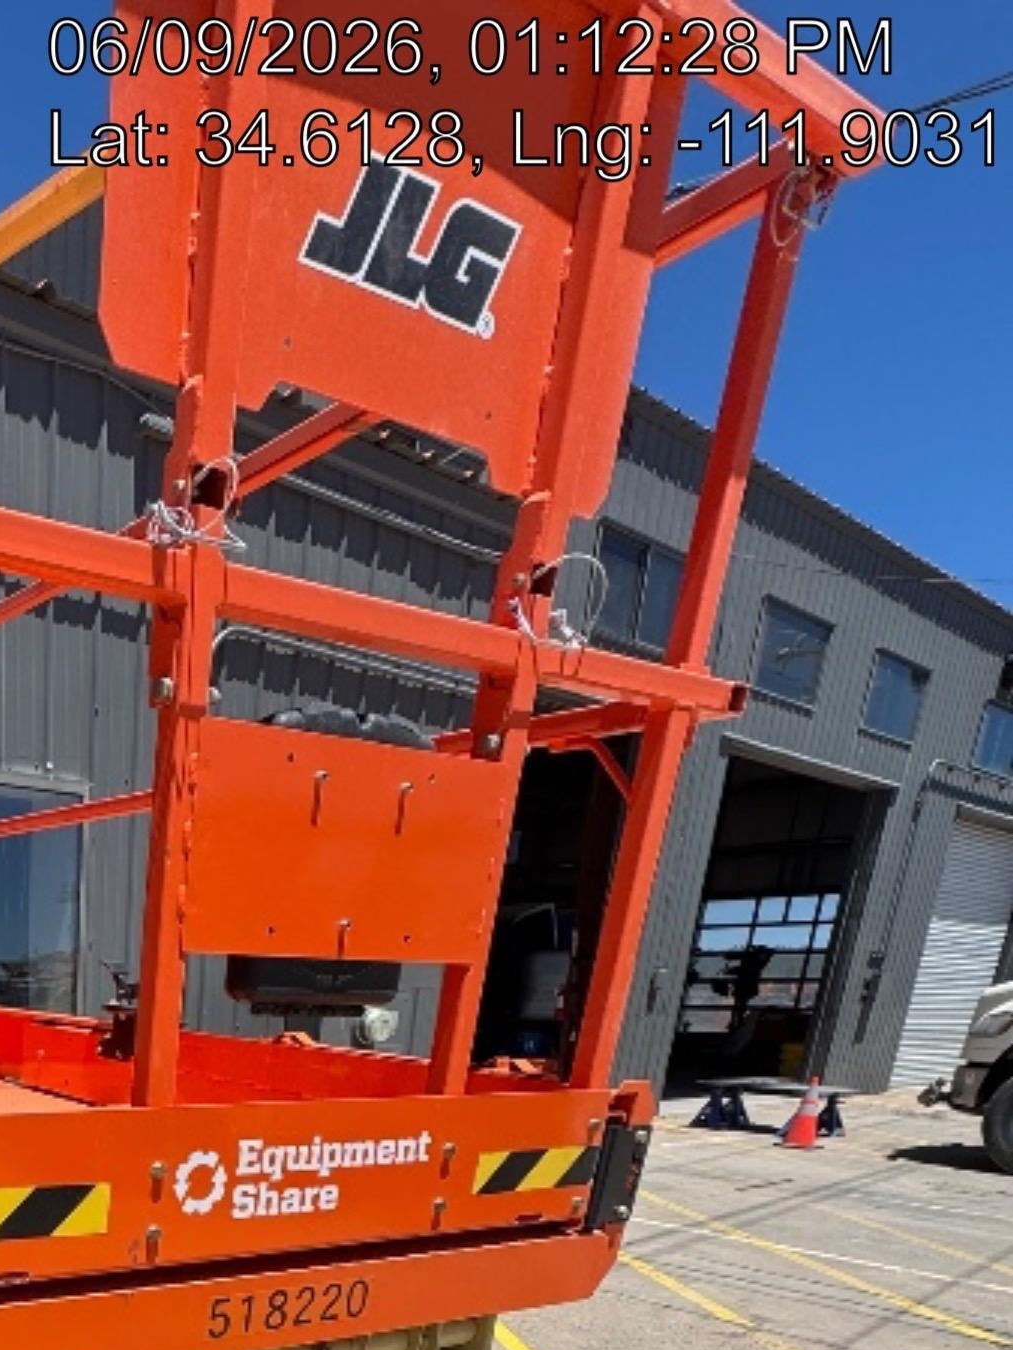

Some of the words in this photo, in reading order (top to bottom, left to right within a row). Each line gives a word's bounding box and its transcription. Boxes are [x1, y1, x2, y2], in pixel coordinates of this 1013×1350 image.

[298, 151, 523, 337] JLG
[235, 1130, 432, 1180] Equipment
[231, 1182, 339, 1219] Share
[207, 1280, 370, 1339] 518220
